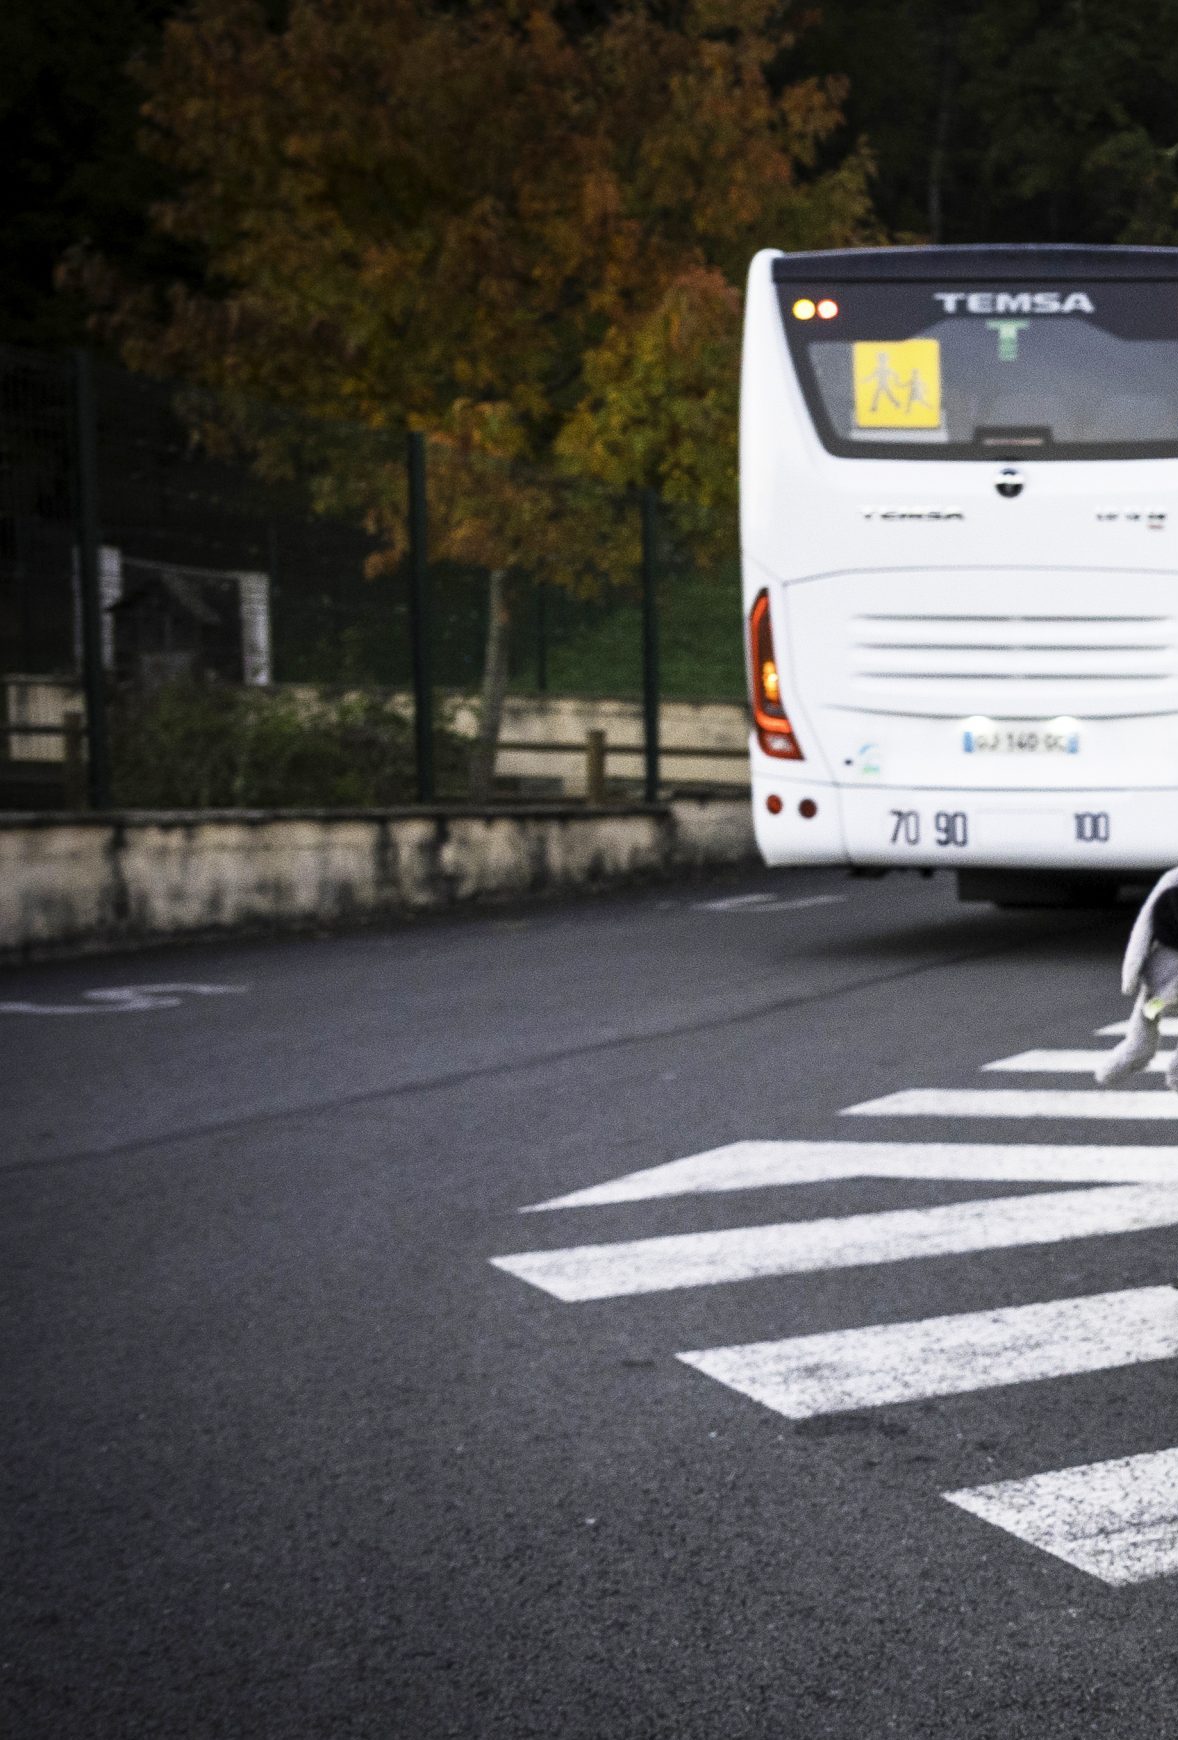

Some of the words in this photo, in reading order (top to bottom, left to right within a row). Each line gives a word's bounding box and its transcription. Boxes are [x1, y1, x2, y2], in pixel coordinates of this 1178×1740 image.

[933, 292, 1094, 314] TEMSA
[890, 809, 920, 845] 70
[935, 811, 968, 847] 90
[1075, 811, 1110, 842] 100
